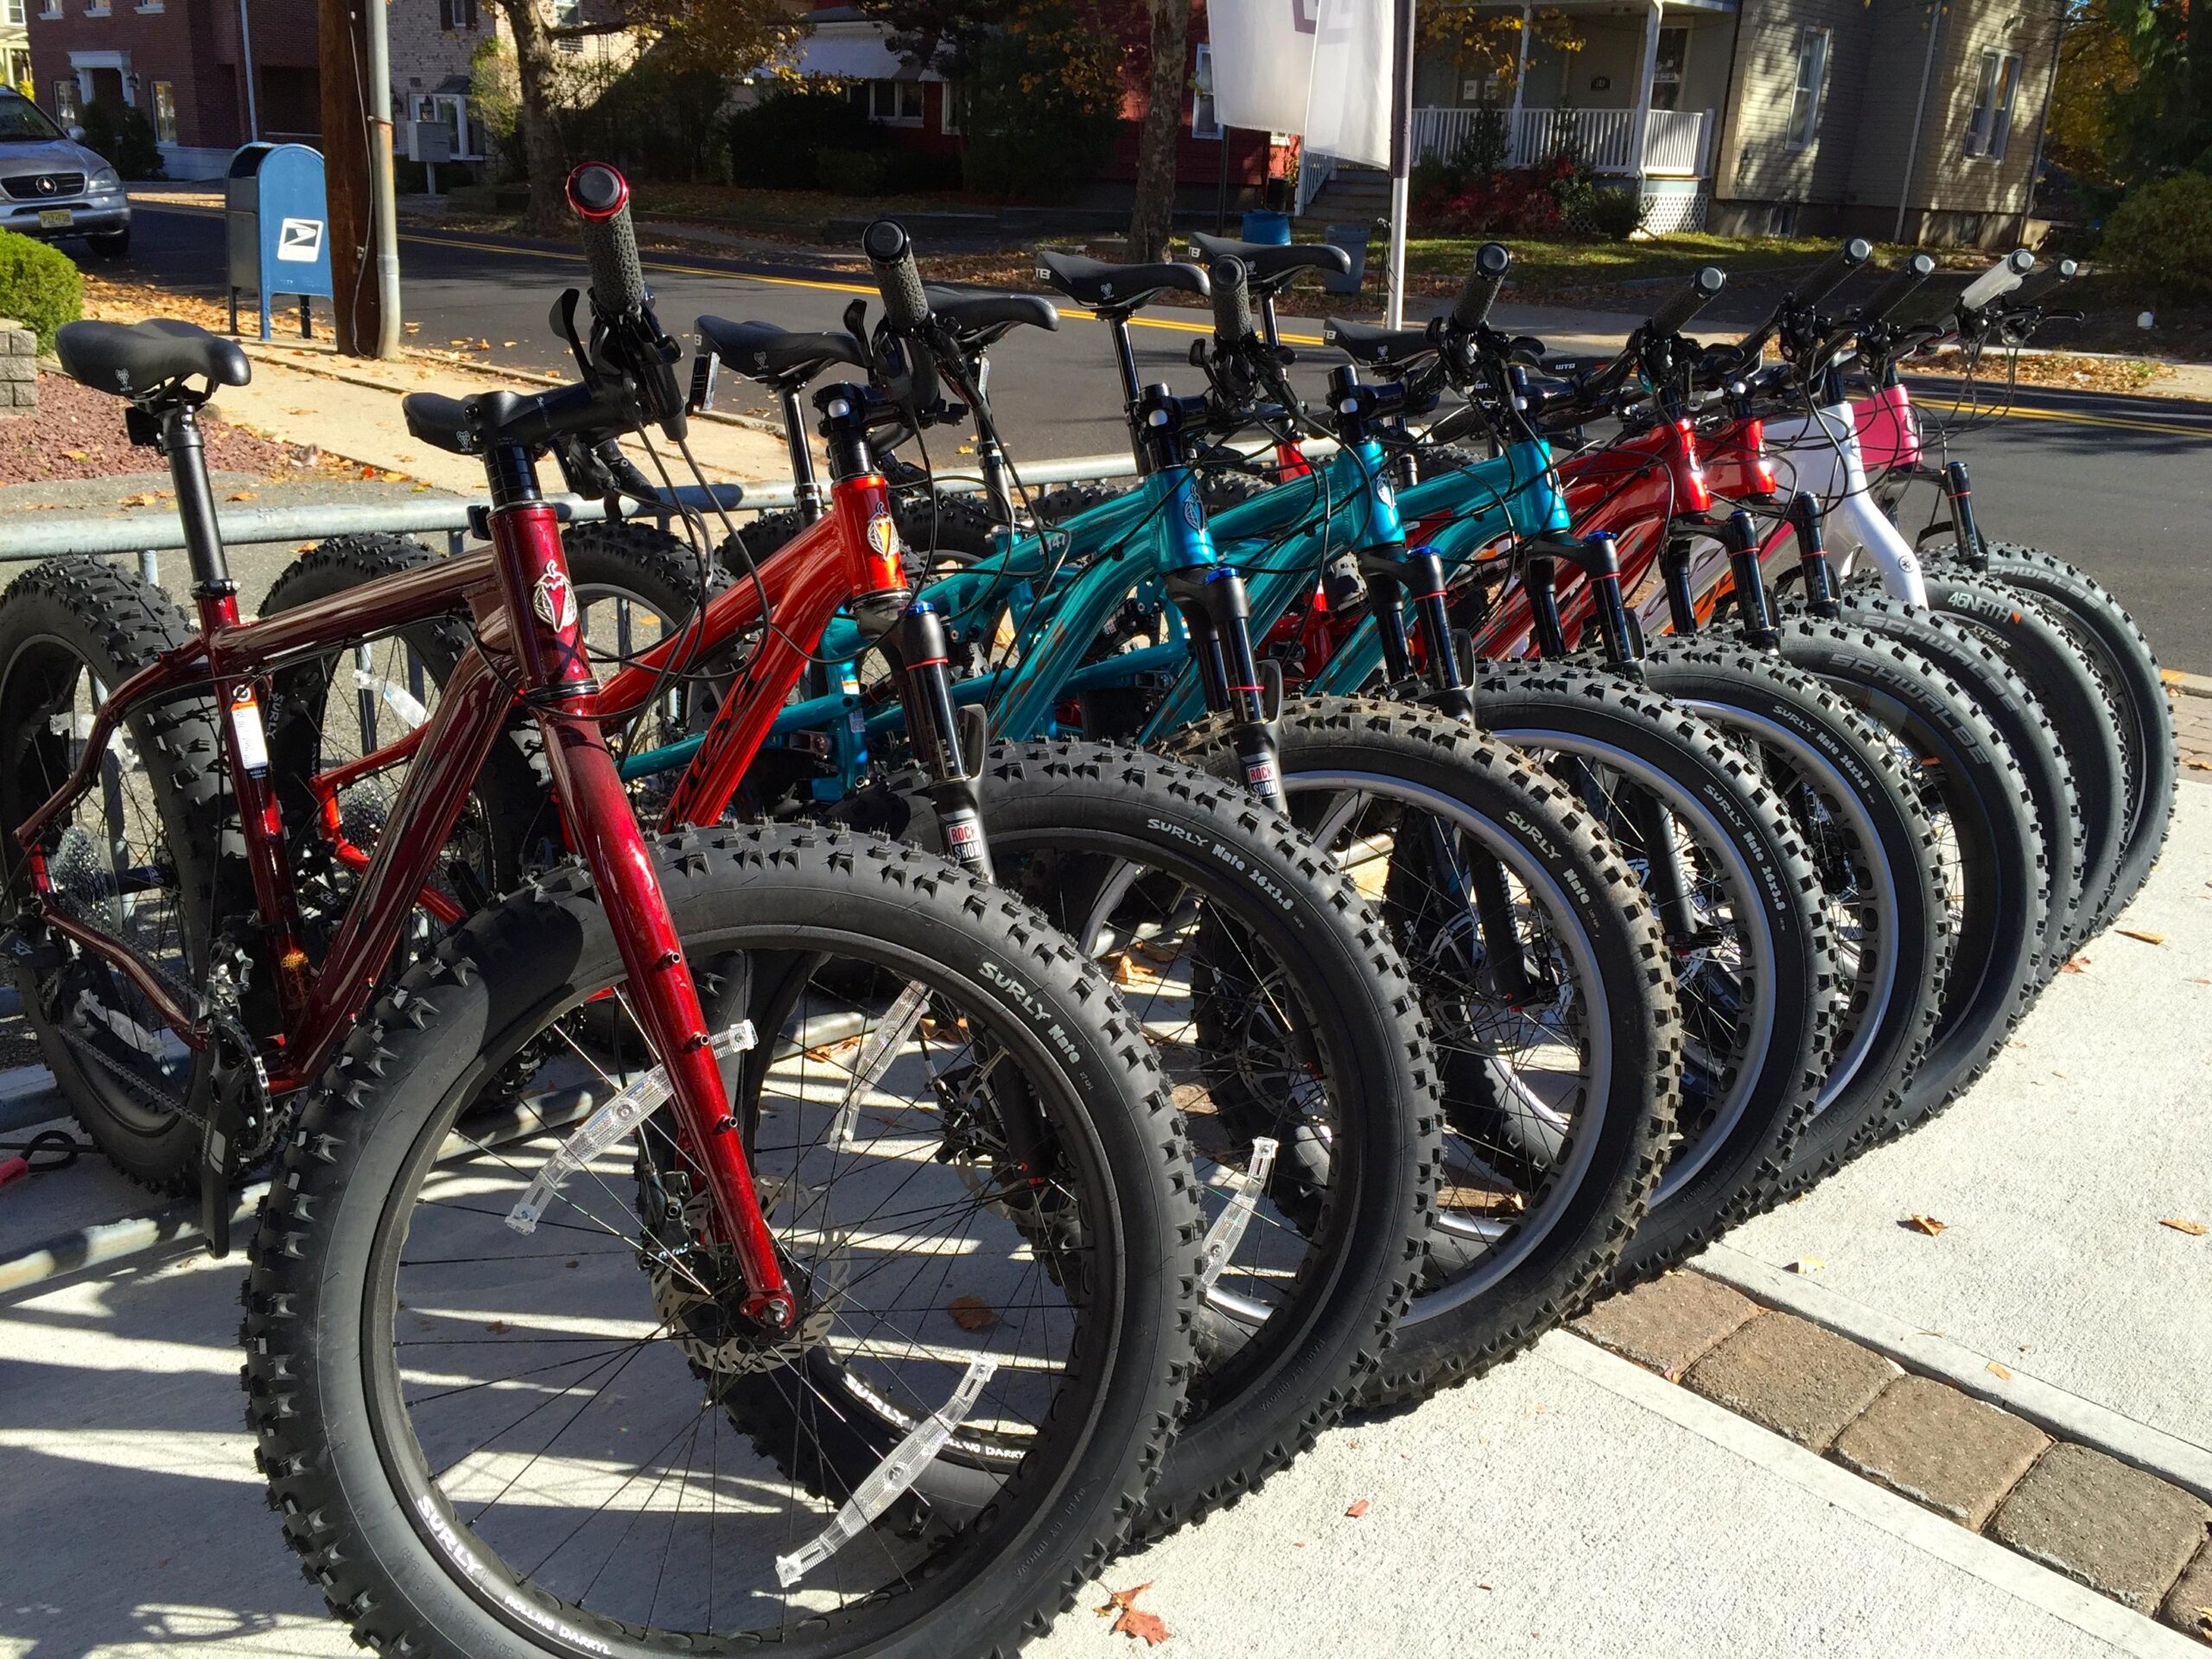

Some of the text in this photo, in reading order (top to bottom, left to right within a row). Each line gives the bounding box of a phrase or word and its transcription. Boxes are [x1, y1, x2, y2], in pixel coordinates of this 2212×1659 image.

[1948, 592, 2012, 623] 45NRTH
[1988, 565, 2101, 609] CHWALBE
[1862, 614, 2018, 713] SCHWALBE
[1969, 626, 2012, 650] SURLY
[265, 692, 284, 740] SURLY
[1828, 652, 1991, 765] SCHWALBE
[1249, 766, 1273, 782] ROCK
[1773, 705, 1871, 789] SURLY Nate 26x3.8
[950, 826, 976, 842] ROCK
[1147, 818, 1294, 911] SURLY Nate 26x3.8
[1505, 810, 1562, 859] SURLY
[1562, 868, 1590, 905] Nate
[1703, 785, 1786, 911] SURLY Nate 26x3.8
[978, 961, 1052, 1020] SURLY
[1047, 1023, 1080, 1065] Nate
[842, 1372, 910, 1426] SURLY
[943, 1437, 1027, 1460] OLLING DARRY
[417, 1495, 484, 1576] SURLY
[505, 1595, 613, 1656] ROLLING DARRYL
